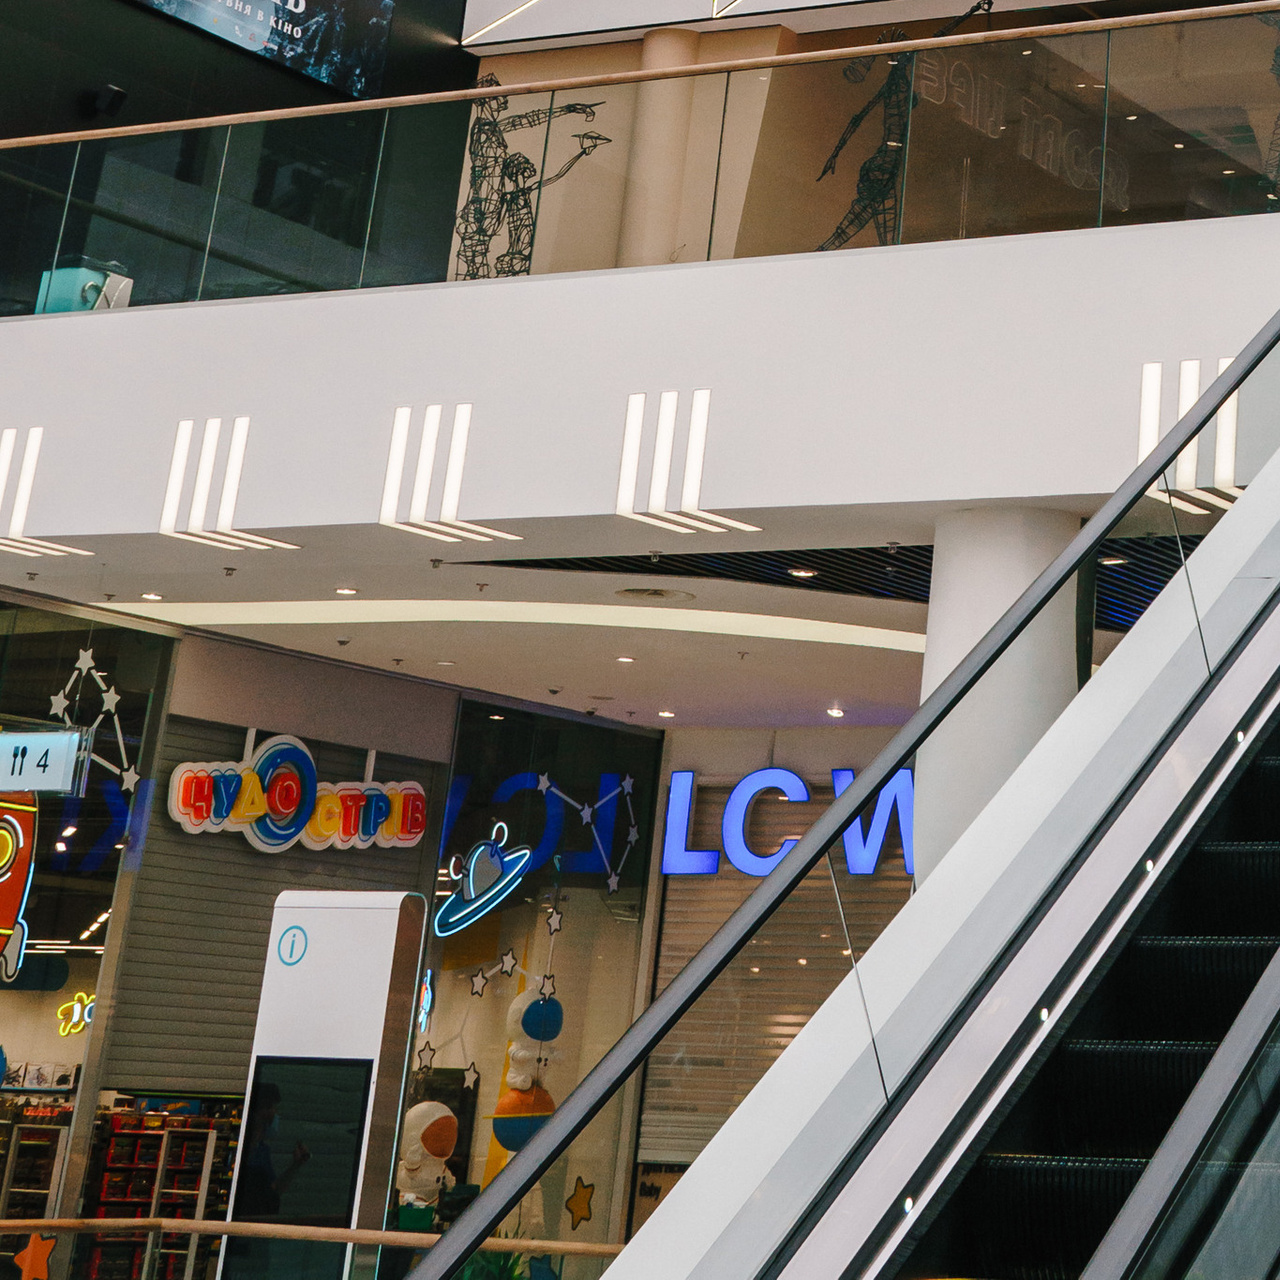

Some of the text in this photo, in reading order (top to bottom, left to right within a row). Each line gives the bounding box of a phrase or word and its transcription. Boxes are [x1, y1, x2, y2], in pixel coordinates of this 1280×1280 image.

[257, 10, 264, 22] В
[269, 15, 302, 38] КІНО
[36, 748, 49, 774] 4
